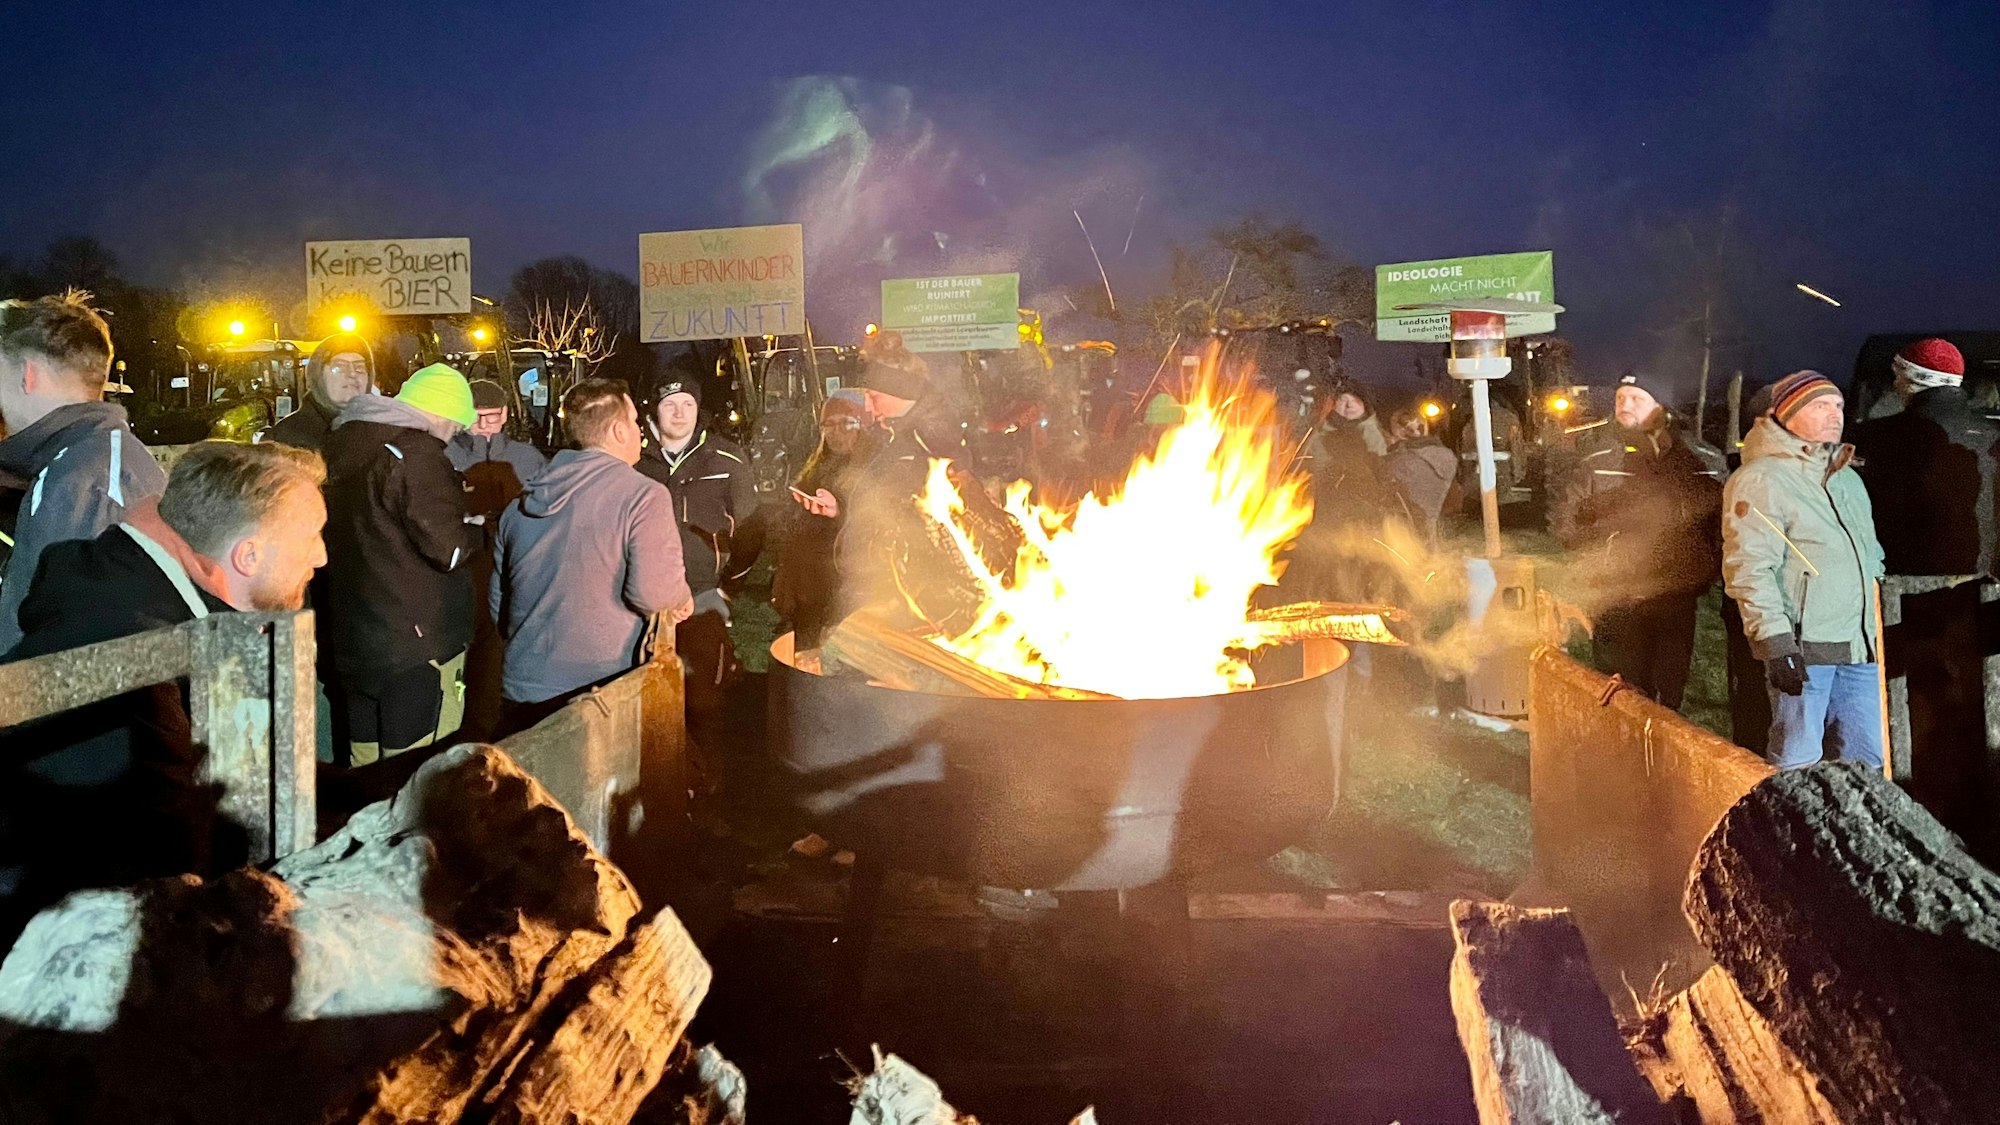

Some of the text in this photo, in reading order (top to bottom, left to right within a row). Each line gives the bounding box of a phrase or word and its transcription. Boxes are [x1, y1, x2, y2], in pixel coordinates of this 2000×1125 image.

[310, 243, 468, 277] Keine Bauern
[643, 256, 795, 287] BAUERNKINDER
[1388, 265, 1463, 282] IDEOLOGIE
[916, 278, 982, 289] IST DER BAUER
[1430, 276, 1518, 293] MACHT NICHT
[380, 276, 459, 309] BIER
[927, 290, 971, 300] RUINIERT
[650, 302, 792, 339] ZUKUNFT
[921, 313, 977, 324] IMPORTIERT
